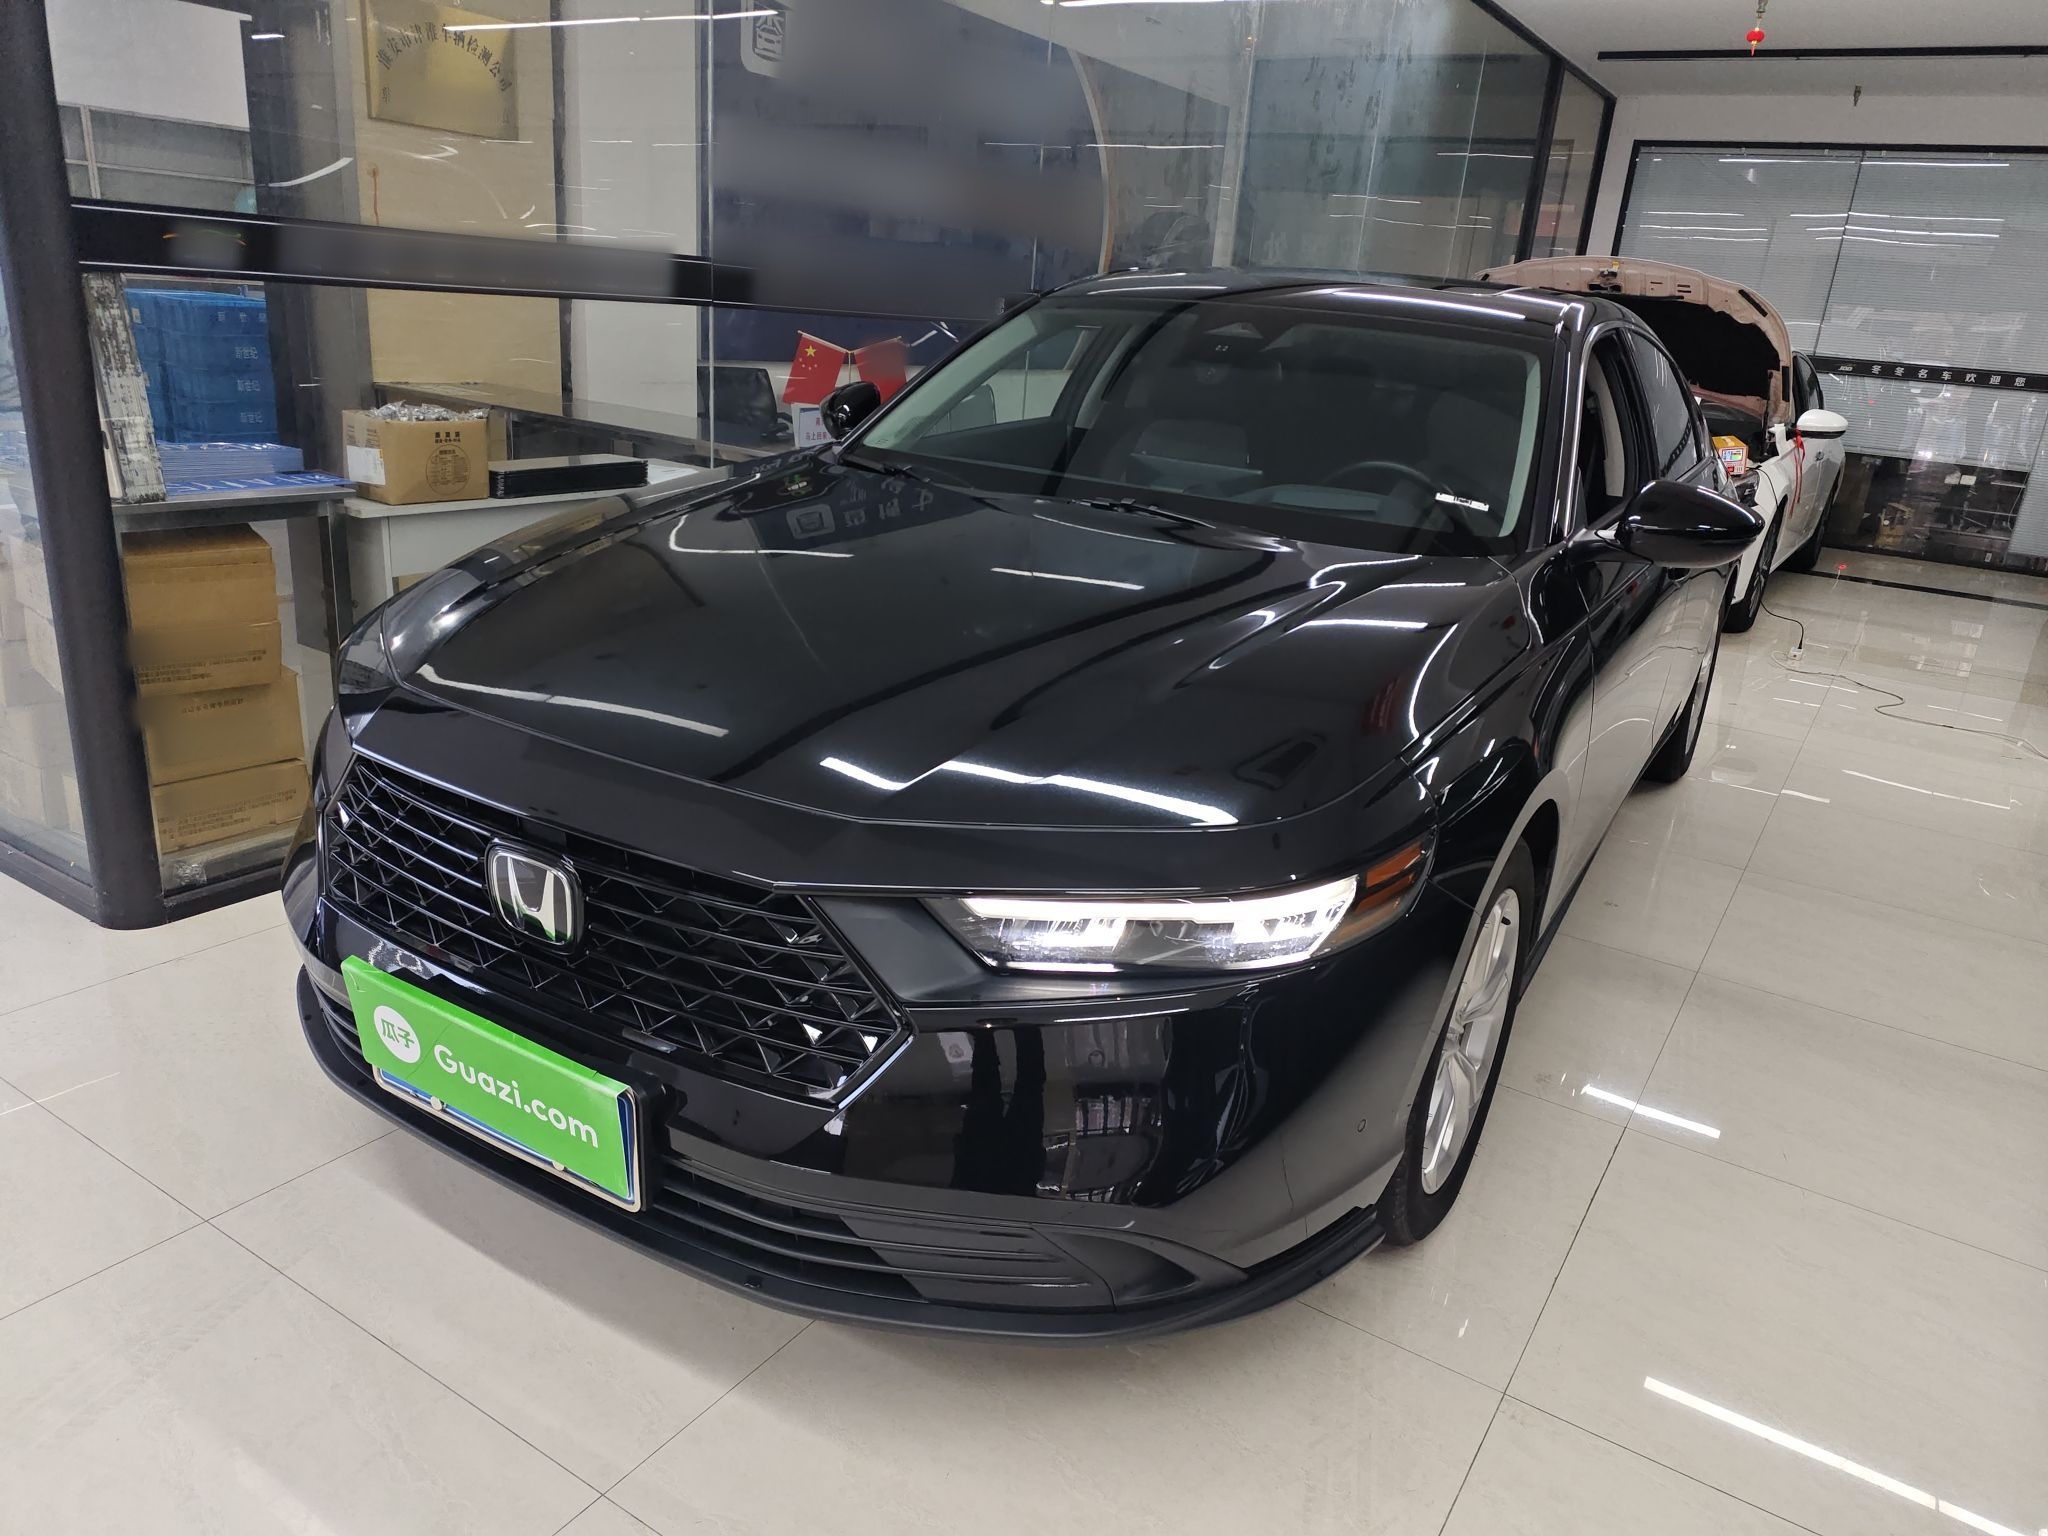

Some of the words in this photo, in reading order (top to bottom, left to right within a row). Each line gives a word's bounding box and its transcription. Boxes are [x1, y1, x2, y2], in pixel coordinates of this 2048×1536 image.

[1871, 365, 2026, 386] 冬冬名车欢迎您
[381, 1020, 415, 1049] 瓜子
[434, 1044, 599, 1149] Guazi.com
